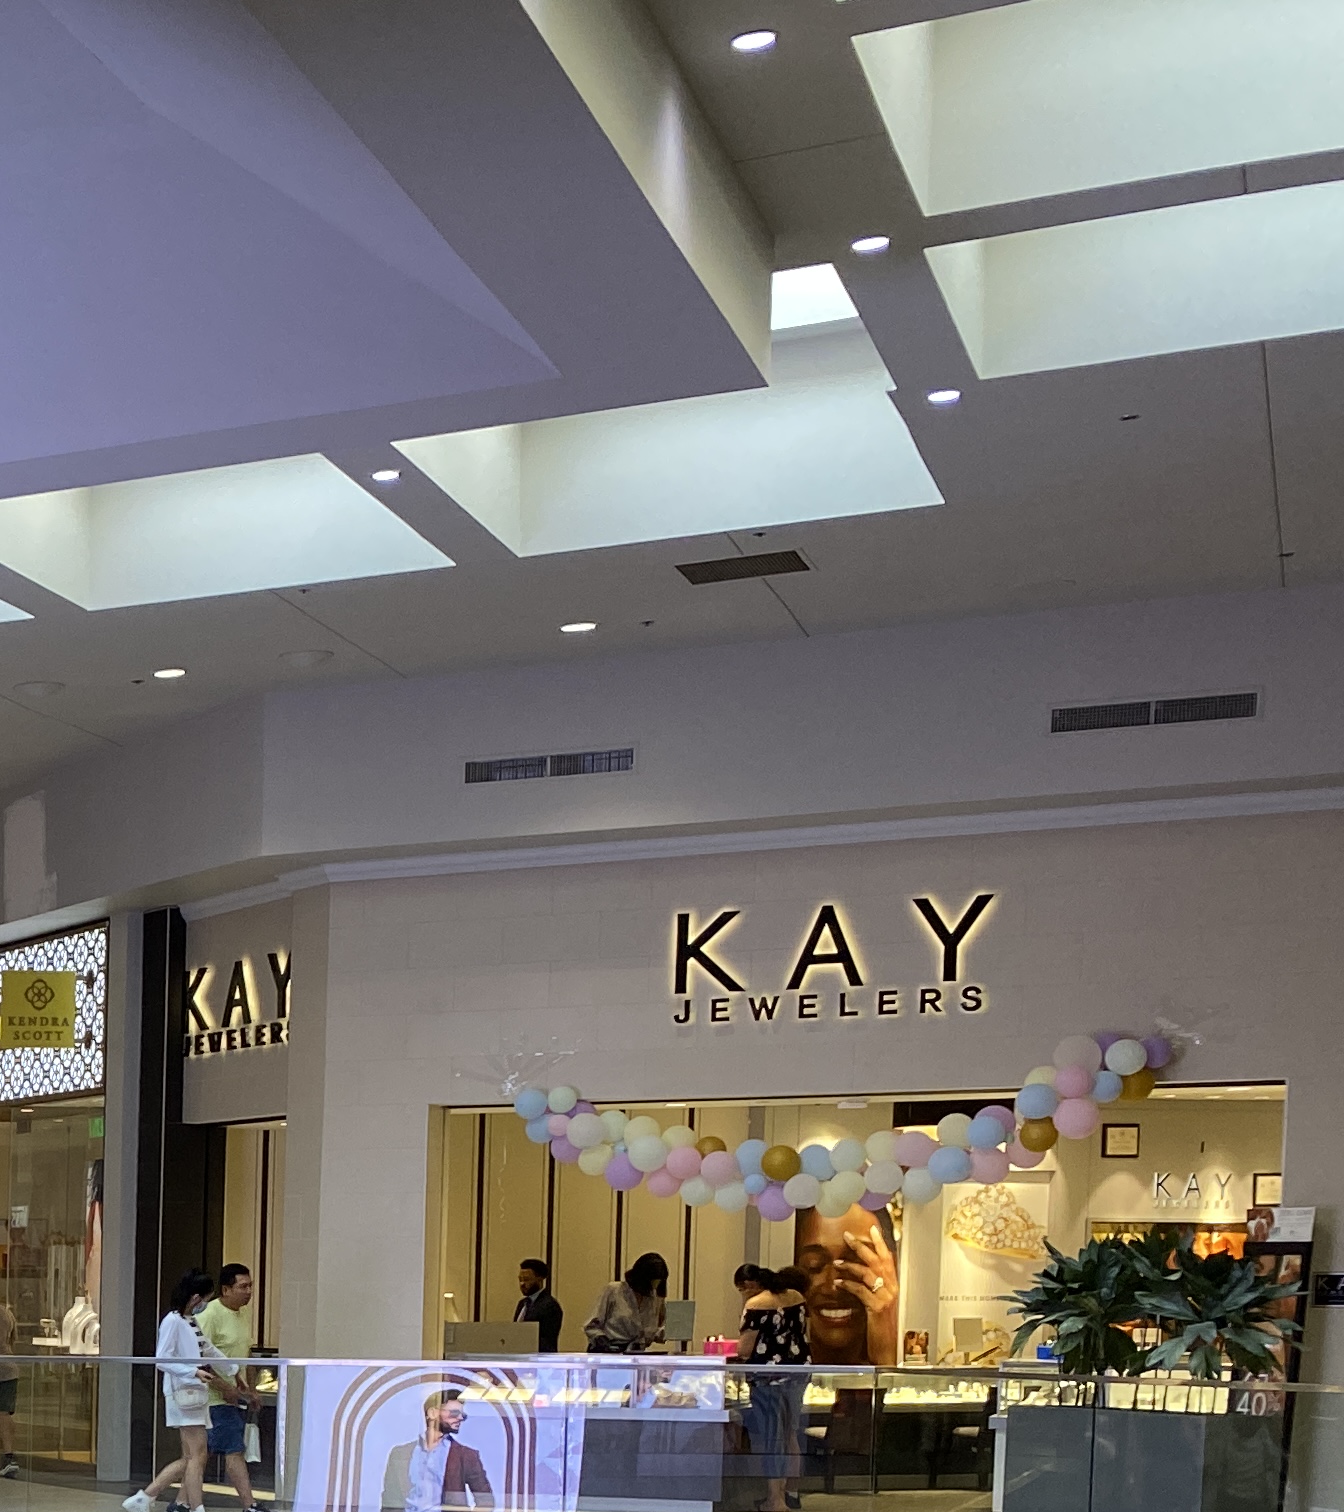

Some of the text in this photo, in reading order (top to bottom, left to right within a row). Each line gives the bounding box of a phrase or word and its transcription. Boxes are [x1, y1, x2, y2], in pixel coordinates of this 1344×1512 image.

[675, 894, 995, 994] KAY
[183, 950, 291, 1035] KAY
[674, 986, 982, 1024] JEWELERS
[8, 1016, 70, 1027] KENDRA
[13, 1030, 64, 1041] SCOTT
[1154, 1172, 1232, 1200] KAY
